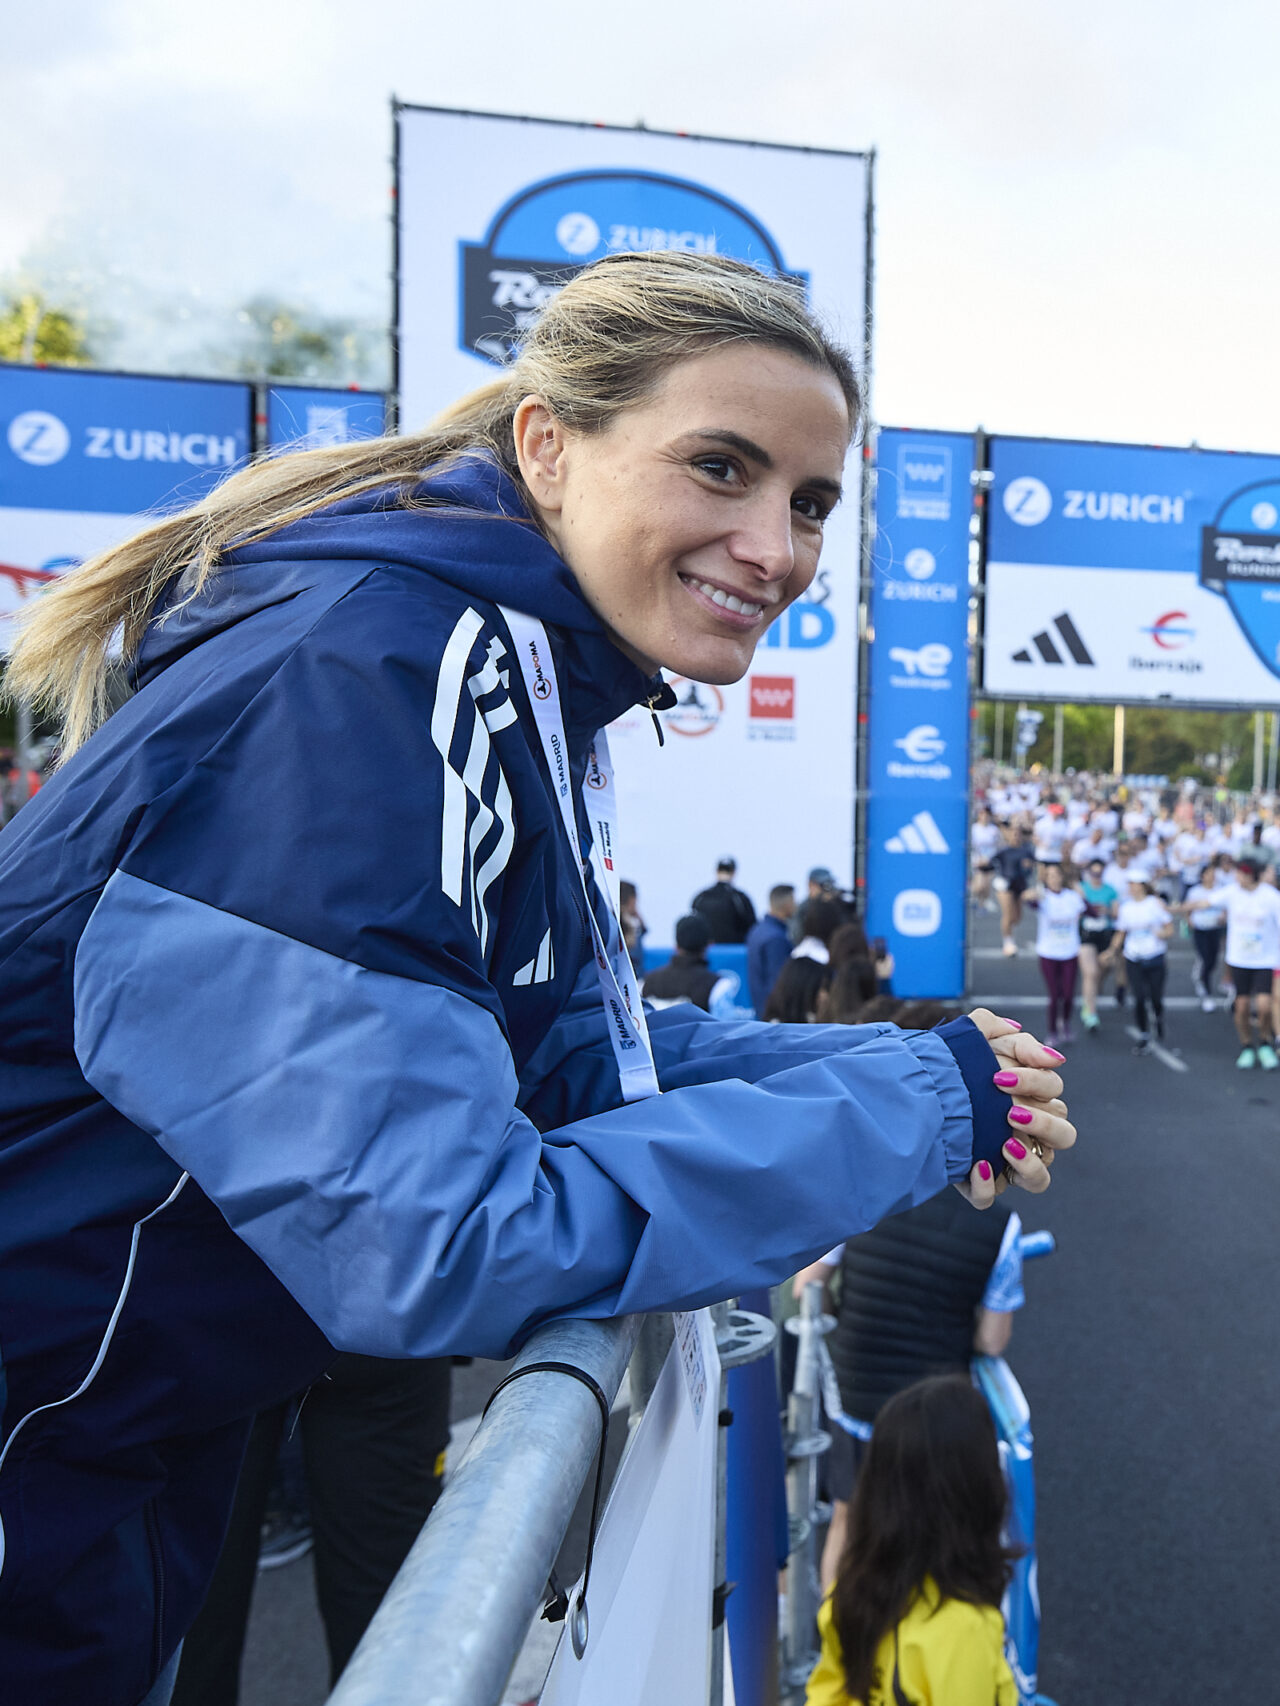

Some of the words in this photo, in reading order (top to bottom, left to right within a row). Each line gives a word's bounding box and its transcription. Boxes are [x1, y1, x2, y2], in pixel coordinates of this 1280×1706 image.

[609, 224, 717, 255] ZURICH
[85, 426, 236, 466] ZURICH
[1062, 490, 1185, 524] ZURICH
[882, 580, 958, 602] ZURICH
[528, 640, 545, 682] MAPOMA
[551, 734, 565, 783] MADRID
[609, 999, 631, 1039] MADRID
